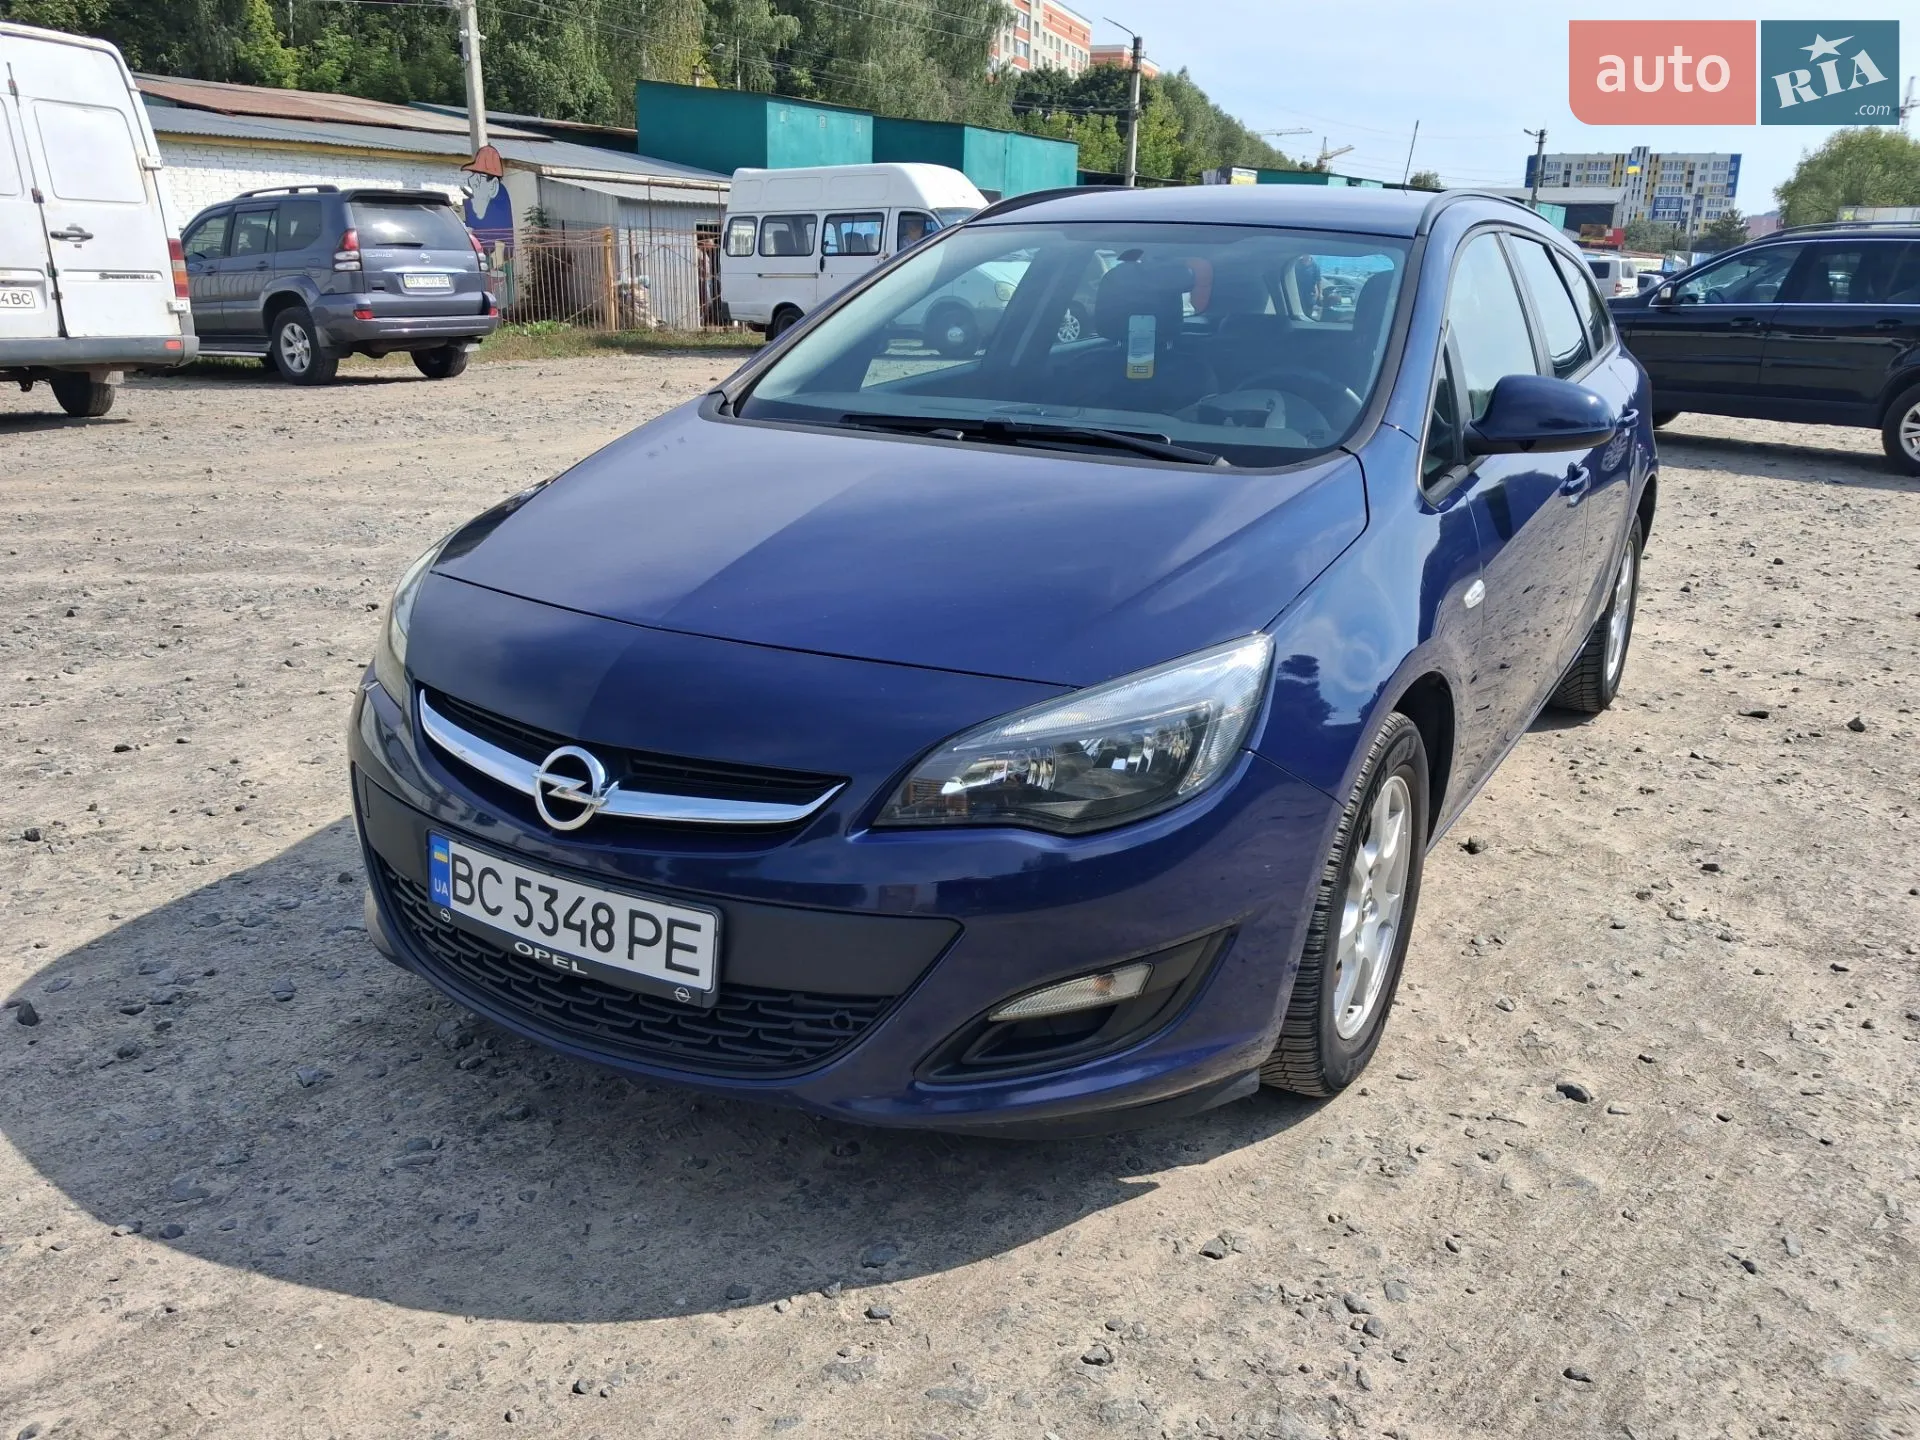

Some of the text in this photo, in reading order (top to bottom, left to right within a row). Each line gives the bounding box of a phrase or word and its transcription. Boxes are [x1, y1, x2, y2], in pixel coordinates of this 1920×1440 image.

[10, 292, 31, 305] BC
[434, 878, 449, 896] UA
[451, 852, 702, 977] BC 5348 PE
[514, 941, 588, 975] OPEL
